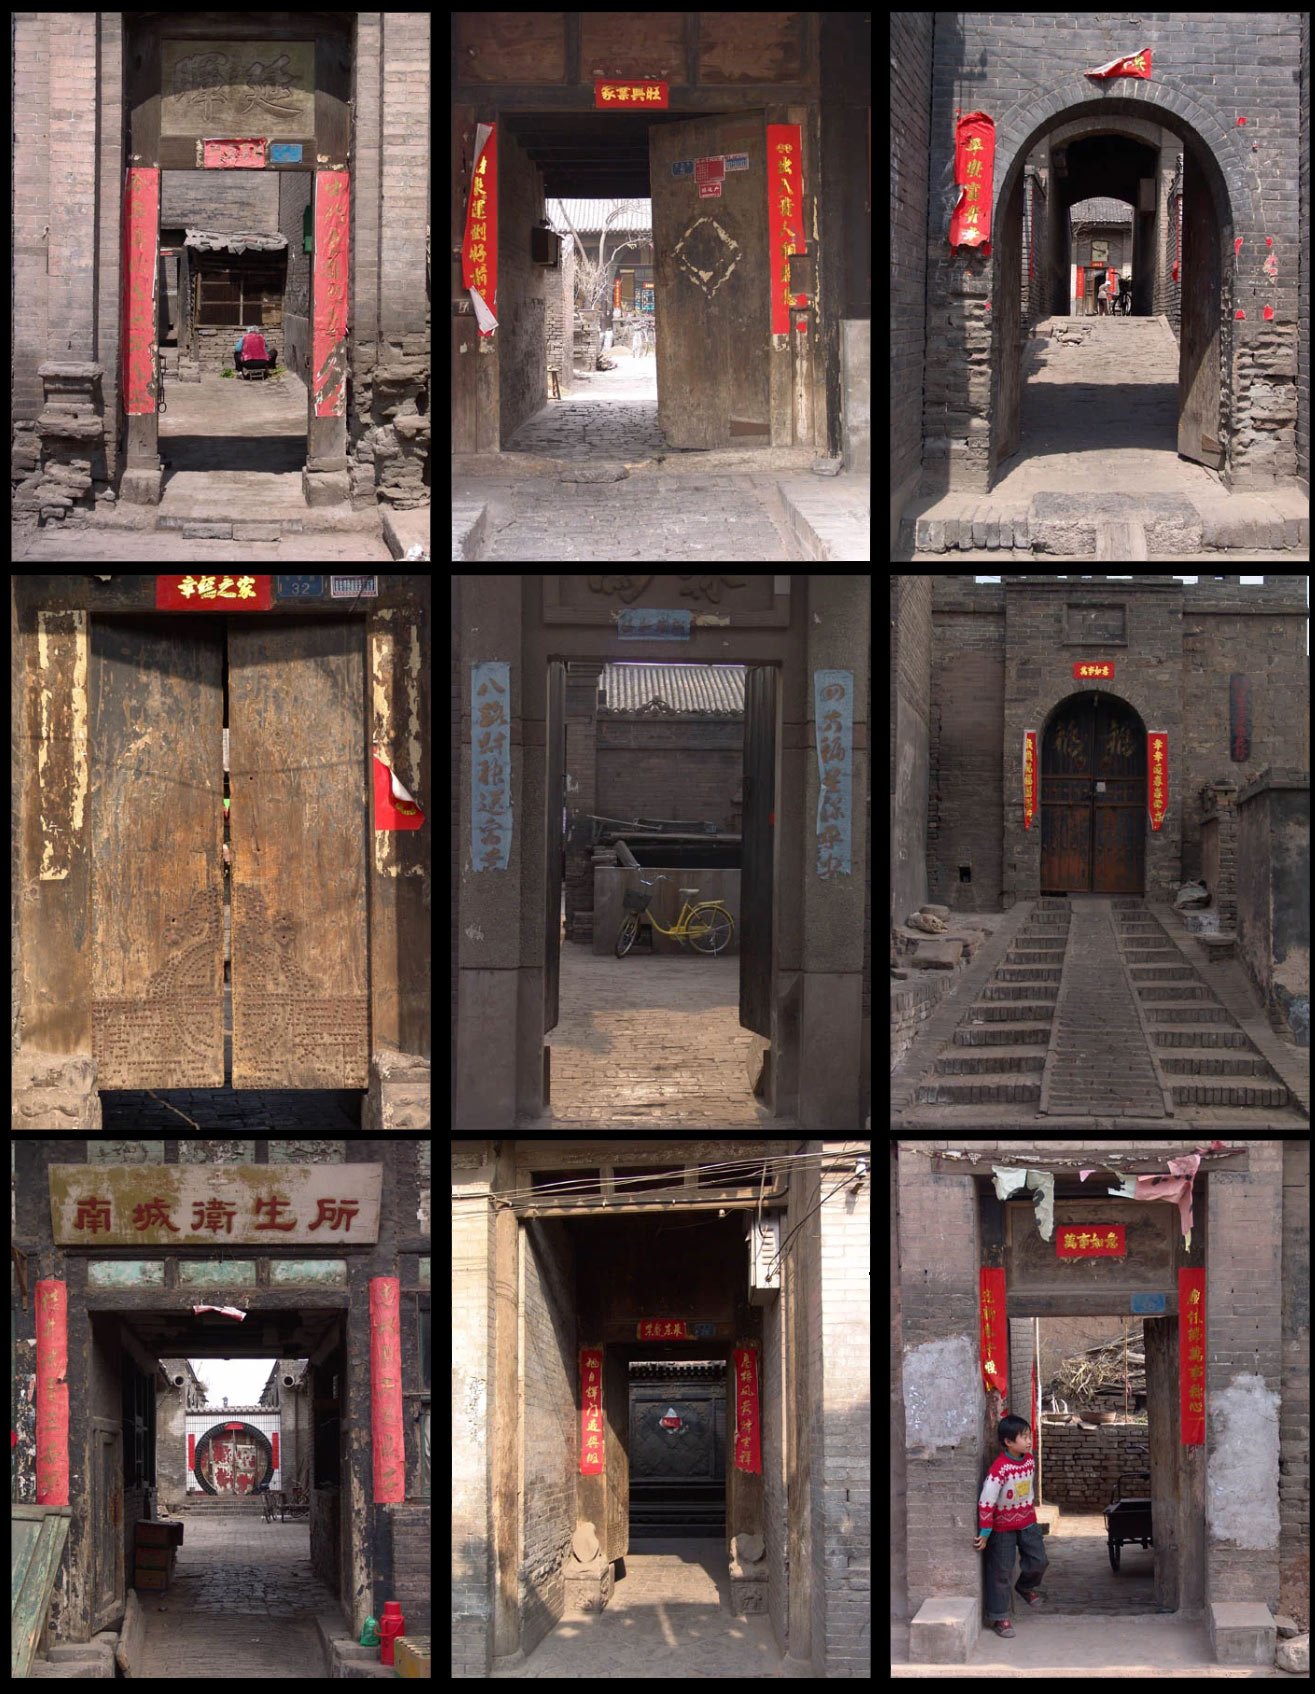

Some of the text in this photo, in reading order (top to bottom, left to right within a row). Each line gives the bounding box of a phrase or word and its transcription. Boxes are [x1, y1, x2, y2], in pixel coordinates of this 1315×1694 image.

[291, 583, 310, 595] 32
[73, 1195, 360, 1235] 南城衛生所
[1063, 1231, 1119, 1250] 萬事如意
